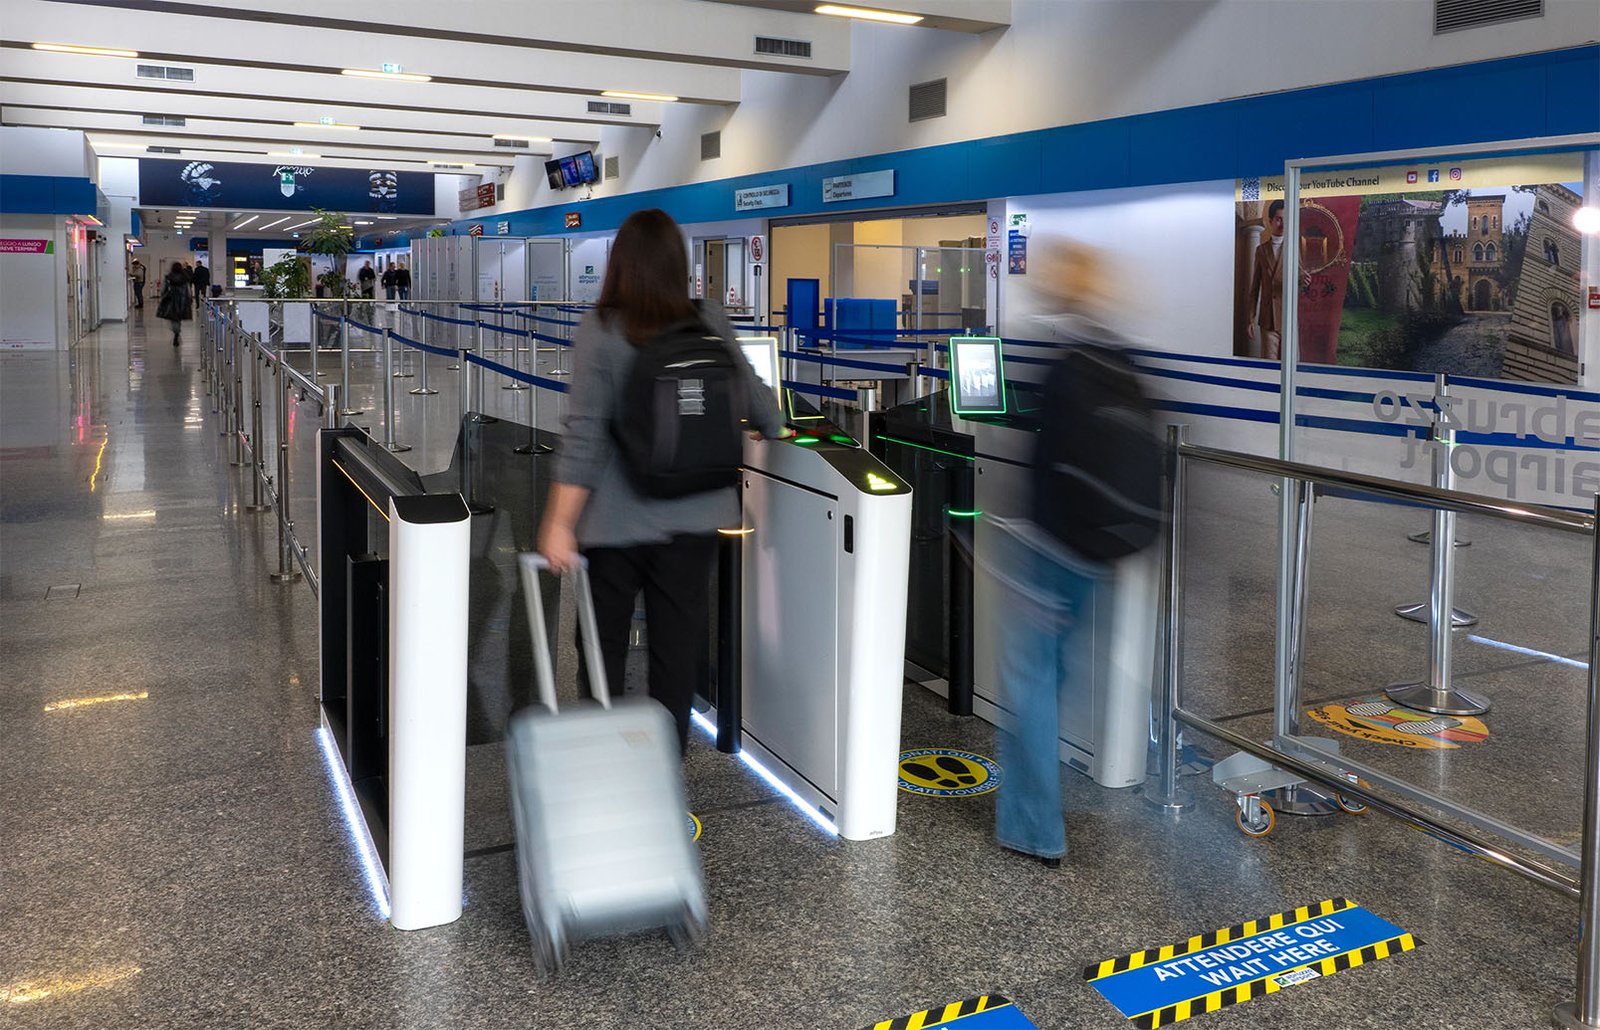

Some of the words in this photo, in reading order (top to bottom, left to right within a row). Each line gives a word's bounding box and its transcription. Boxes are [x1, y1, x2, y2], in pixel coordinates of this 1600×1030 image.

[1312, 179, 1344, 189] YouTube
[1346, 176, 1380, 187] Channel
[900, 750, 942, 760] ONATI
[948, 751, 974, 759] QUI
[1154, 932, 1297, 981] ATTENDERE
[1295, 918, 1345, 938] QUI
[1198, 958, 1269, 986] WAIT
[1269, 938, 1340, 966] HERE
